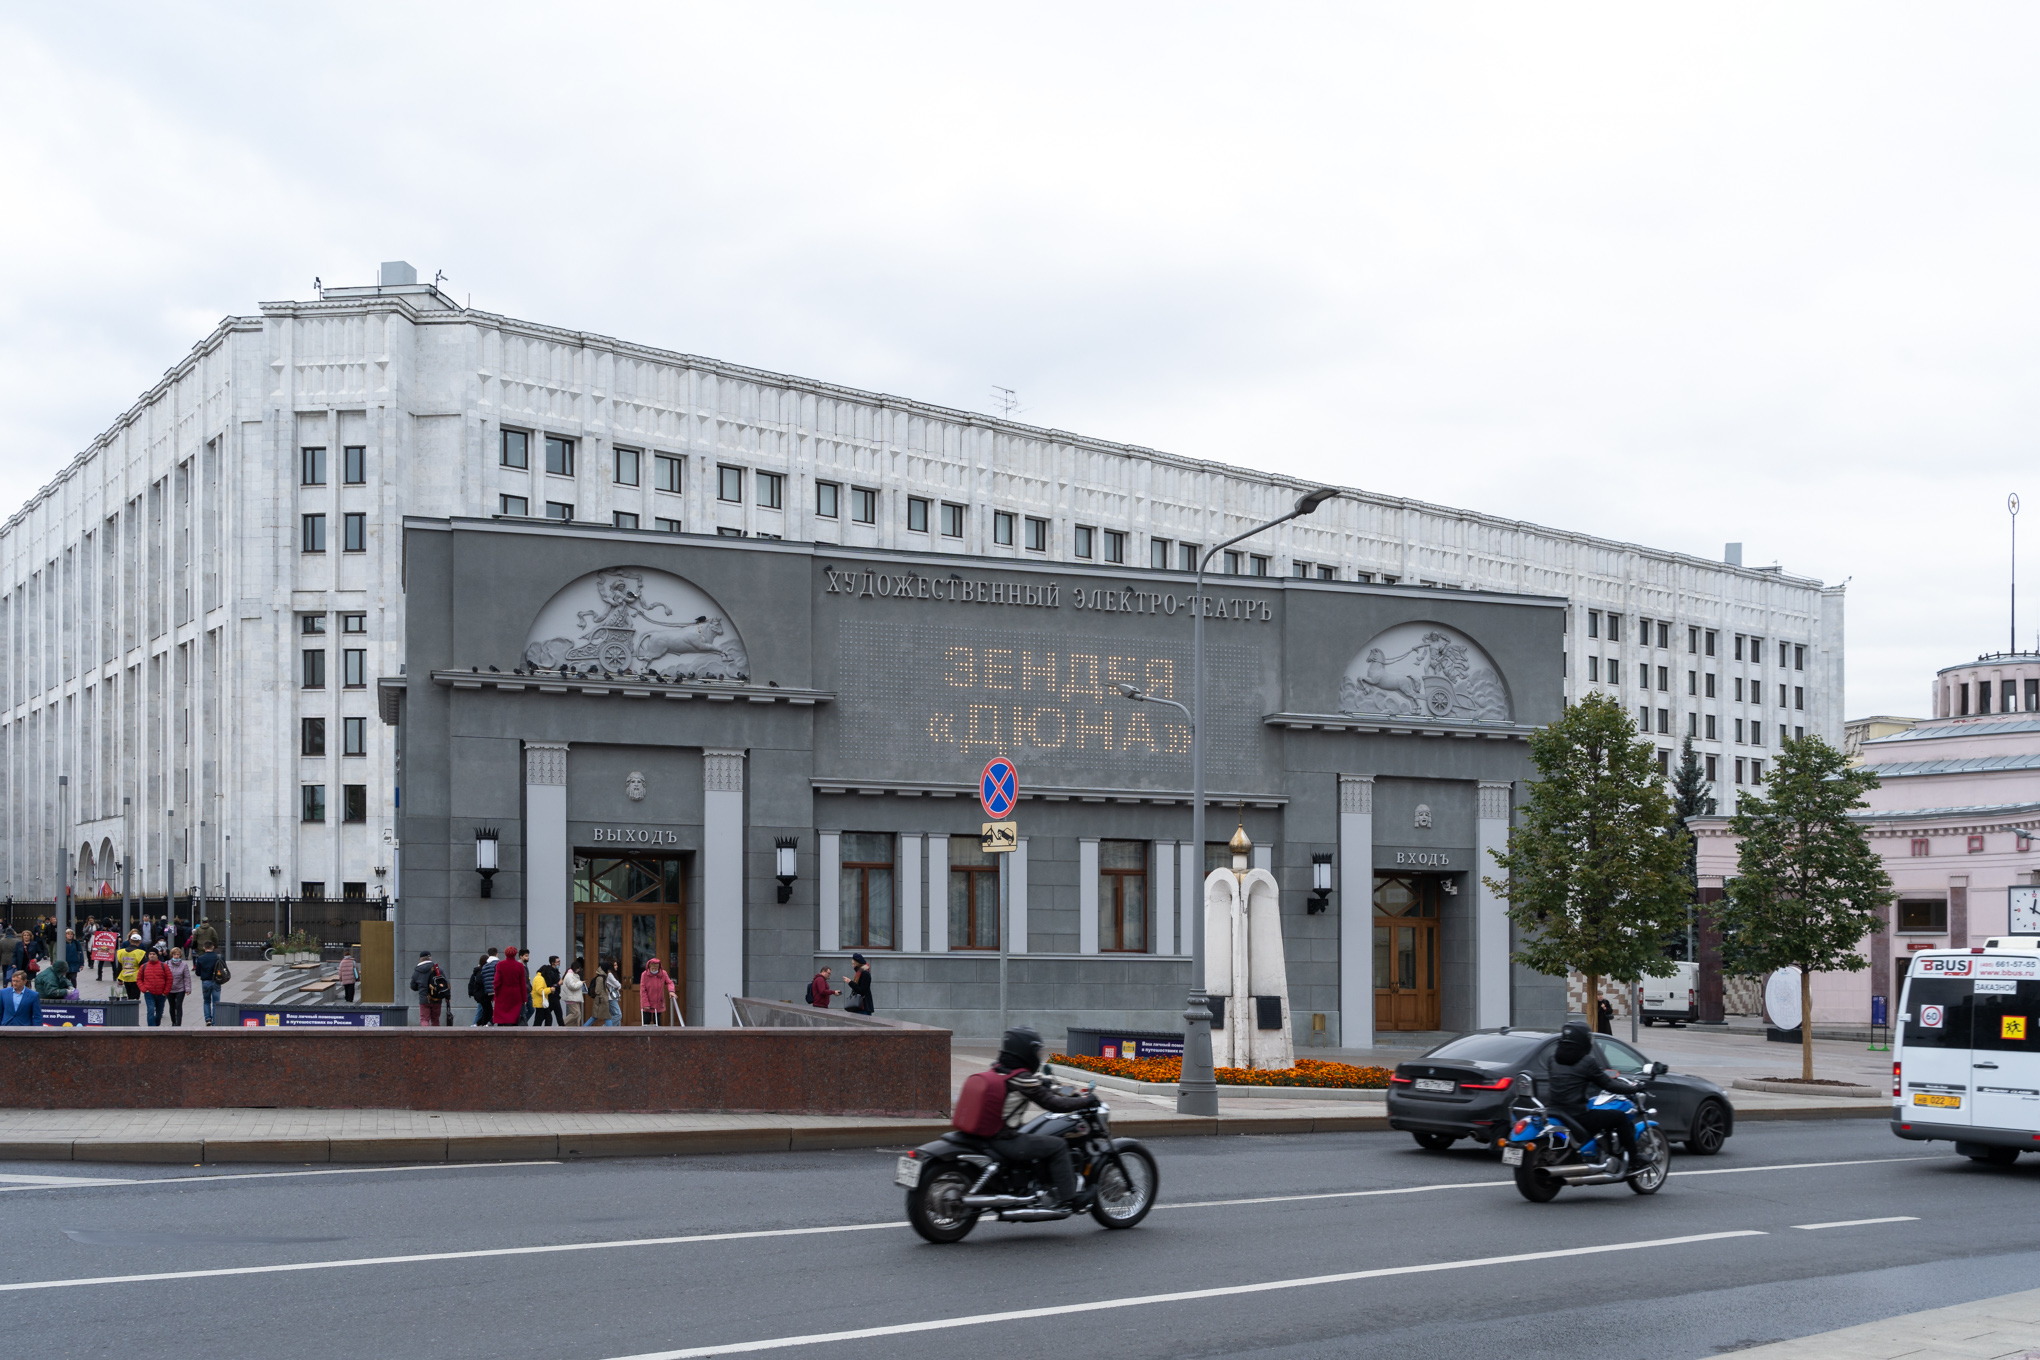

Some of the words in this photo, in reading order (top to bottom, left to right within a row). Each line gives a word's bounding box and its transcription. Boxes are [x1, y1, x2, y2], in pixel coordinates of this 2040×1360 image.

[826, 571, 1061, 608] ХУДОЖЕСТВЕННЫЙ
[1073, 587, 1272, 621] ЭЛЕКТРО-ТЕАТРЪ
[944, 646, 1174, 704] ЗЕНДЕЯ
[925, 704, 1192, 754] «ДЮНА»
[593, 828, 678, 845] ВЫХОДЪ
[1396, 852, 1450, 867] ВХОДЪ
[1921, 960, 1967, 971] BBUS
[1975, 982, 2016, 992] ЗАКАЗНОЙ
[1926, 1012, 1938, 1020] 60
